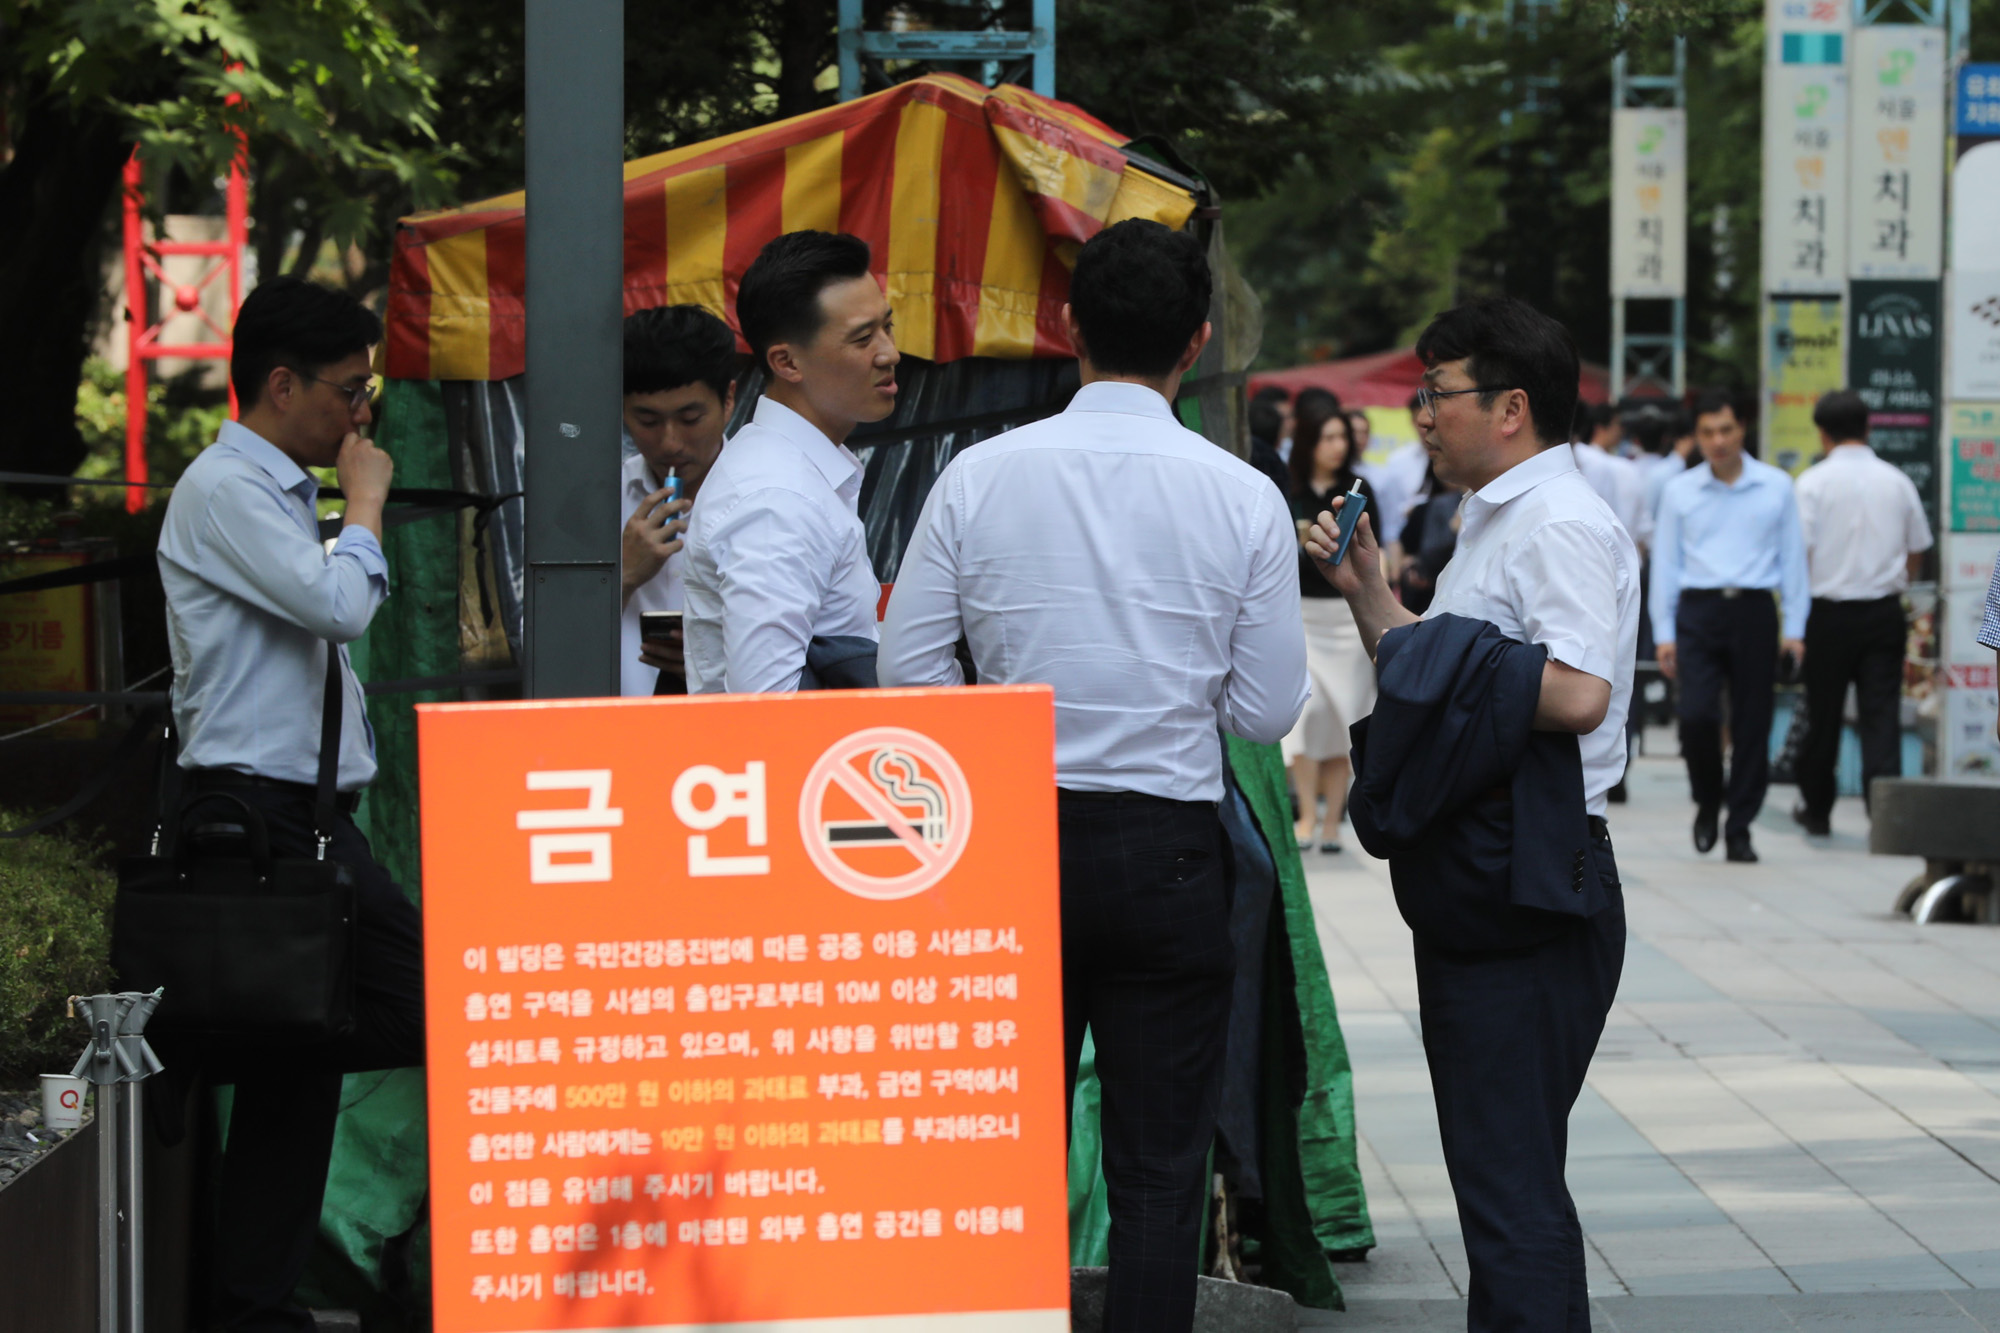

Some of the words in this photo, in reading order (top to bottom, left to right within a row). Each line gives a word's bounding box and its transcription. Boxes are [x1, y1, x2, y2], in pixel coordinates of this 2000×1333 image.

[464, 947, 487, 973] 이
[497, 943, 565, 973] 빌딩은
[574, 936, 754, 969] 국민건강증진법에
[763, 934, 808, 962] 따른
[818, 932, 863, 961] 공중
[873, 930, 918, 958] 이용
[464, 992, 511, 1021] 흡연
[523, 989, 593, 1018] 구역을
[605, 987, 674, 1015] 시설의
[686, 980, 824, 1012] 출입구로부터
[835, 981, 880, 1004] 10M
[891, 976, 938, 1004] 이상
[950, 973, 1018, 1001] 거리에
[466, 1037, 562, 1068] 설치토록
[573, 1034, 668, 1063] 규정하고
[772, 1028, 794, 1055] 위
[806, 1025, 877, 1054] 사항을
[890, 1022, 960, 1050] 위반할
[972, 1020, 1018, 1048] 경우
[468, 1084, 557, 1114] 건물주에
[565, 1083, 627, 1109] 500만
[637, 1080, 660, 1107] 원
[668, 1078, 734, 1104] 이하의
[877, 1070, 922, 1098] 금연
[930, 1066, 1018, 1095] 구역에서
[468, 1132, 536, 1162] 흡연한
[543, 1128, 652, 1158] 사람에게는
[661, 1126, 704, 1152] 10만
[714, 1124, 735, 1150] 원
[743, 1122, 810, 1148] 이하의
[912, 1113, 1020, 1143] 부과하오니
[470, 1181, 493, 1204] 이
[505, 1178, 552, 1207] 점을
[562, 1176, 633, 1204] 유념해
[645, 1173, 713, 1200] 주시기
[471, 1226, 518, 1255] 또한
[529, 1223, 599, 1253] 흡연은
[611, 1221, 667, 1250] 1층에
[678, 1217, 748, 1246] 마련된
[760, 1214, 806, 1242] 외부
[816, 1212, 863, 1241] 흡연
[874, 1208, 942, 1239] 공간을
[955, 1206, 1024, 1235] 이용해
[471, 1273, 542, 1302] 주시기
